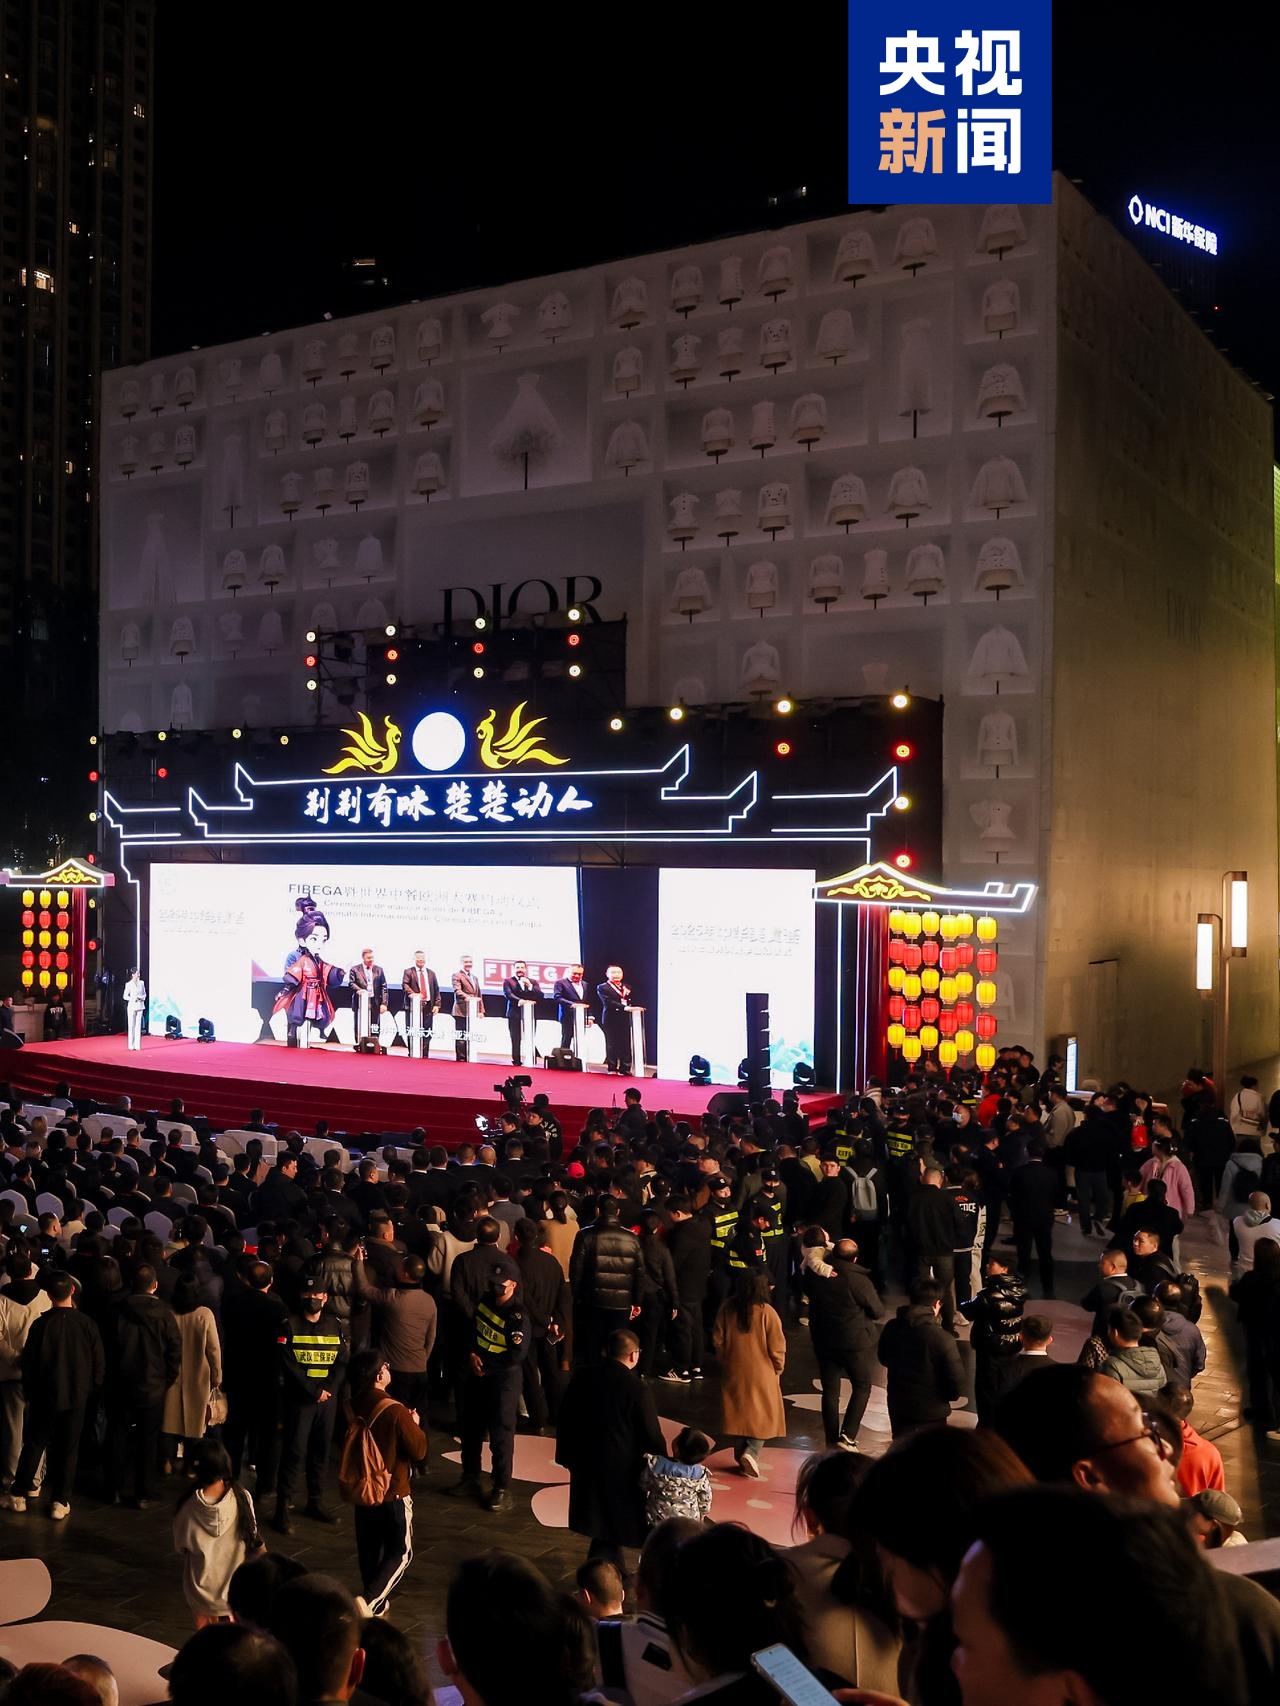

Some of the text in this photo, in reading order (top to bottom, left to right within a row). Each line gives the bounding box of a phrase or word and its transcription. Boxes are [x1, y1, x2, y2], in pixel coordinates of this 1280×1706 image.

[1145, 203, 1218, 256] NCI 新华保险
[441, 575, 606, 633] DIOR
[303, 780, 594, 828] 荆荆有味 楚楚动人
[288, 883, 342, 896] FIBEGA
[485, 964, 572, 982] FIEG
